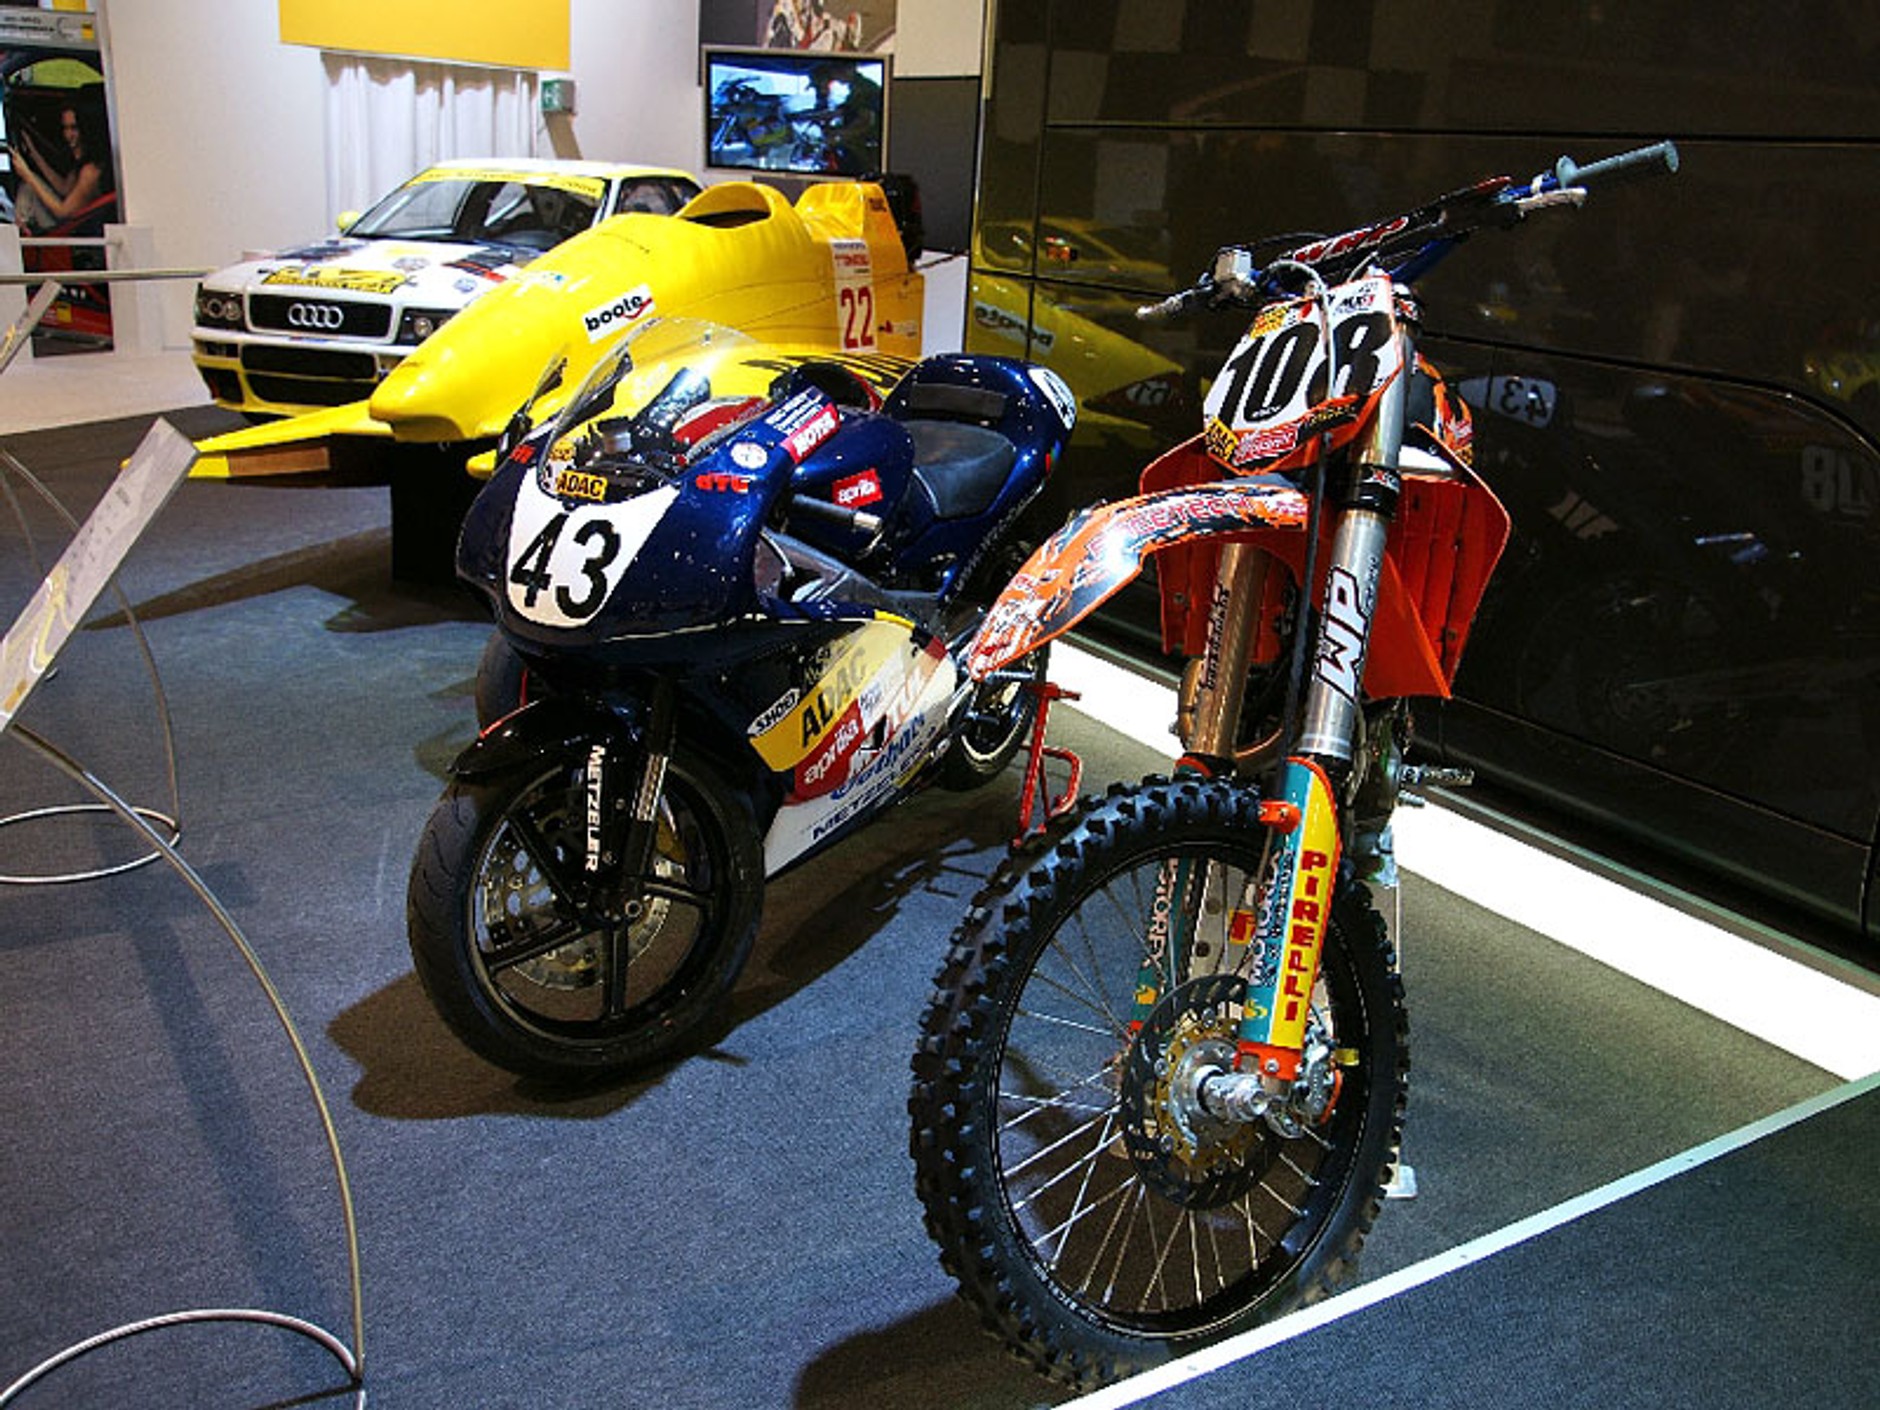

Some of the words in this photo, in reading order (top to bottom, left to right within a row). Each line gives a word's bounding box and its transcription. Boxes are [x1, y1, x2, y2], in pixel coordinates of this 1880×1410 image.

[841, 286, 874, 349] 22
[1218, 310, 1393, 428] 108
[510, 512, 621, 619] 43
[1316, 565, 1370, 704] WP
[801, 648, 867, 749] ADAC
[804, 718, 860, 784] aprilia
[585, 744, 606, 872] METZELER
[1284, 850, 1328, 1021] PIRELLI
